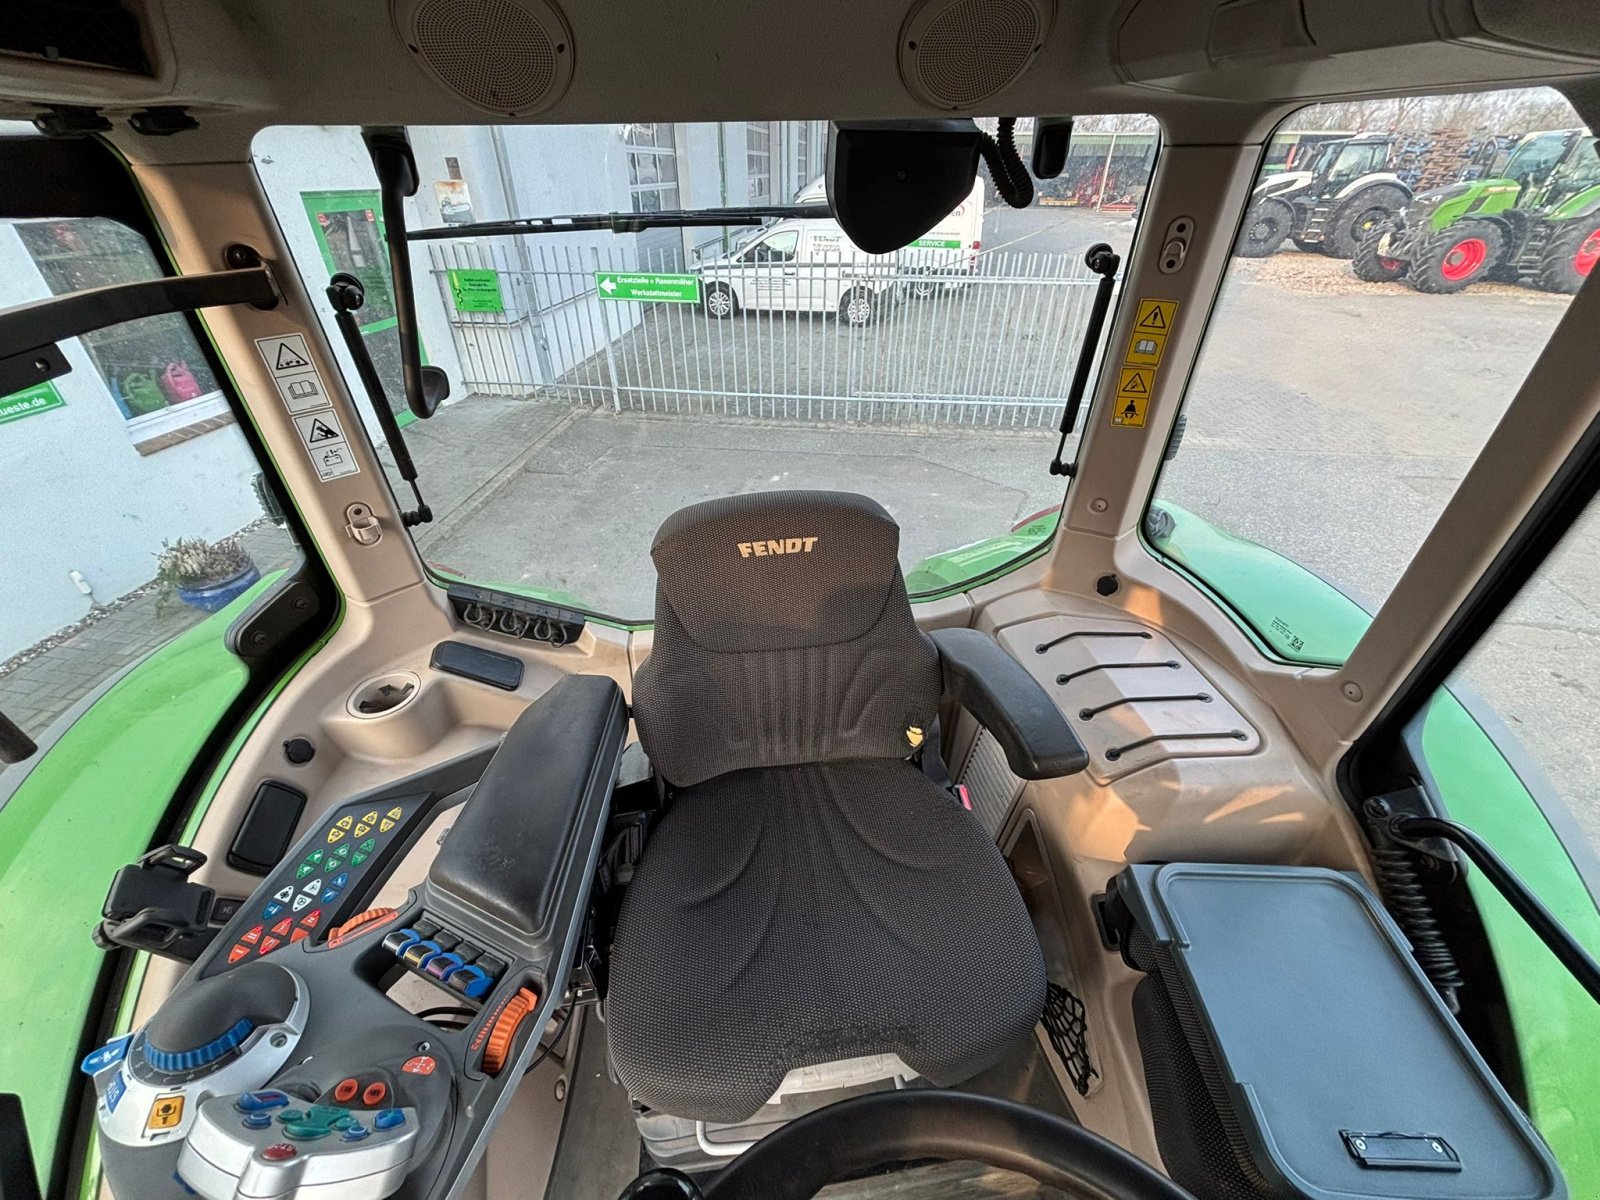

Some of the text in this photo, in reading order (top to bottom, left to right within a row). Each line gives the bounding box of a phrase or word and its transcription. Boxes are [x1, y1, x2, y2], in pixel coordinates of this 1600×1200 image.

[918, 239, 946, 248] SERVICE
[0, 397, 47, 416] ueste.de
[737, 536, 819, 558] FENDT
